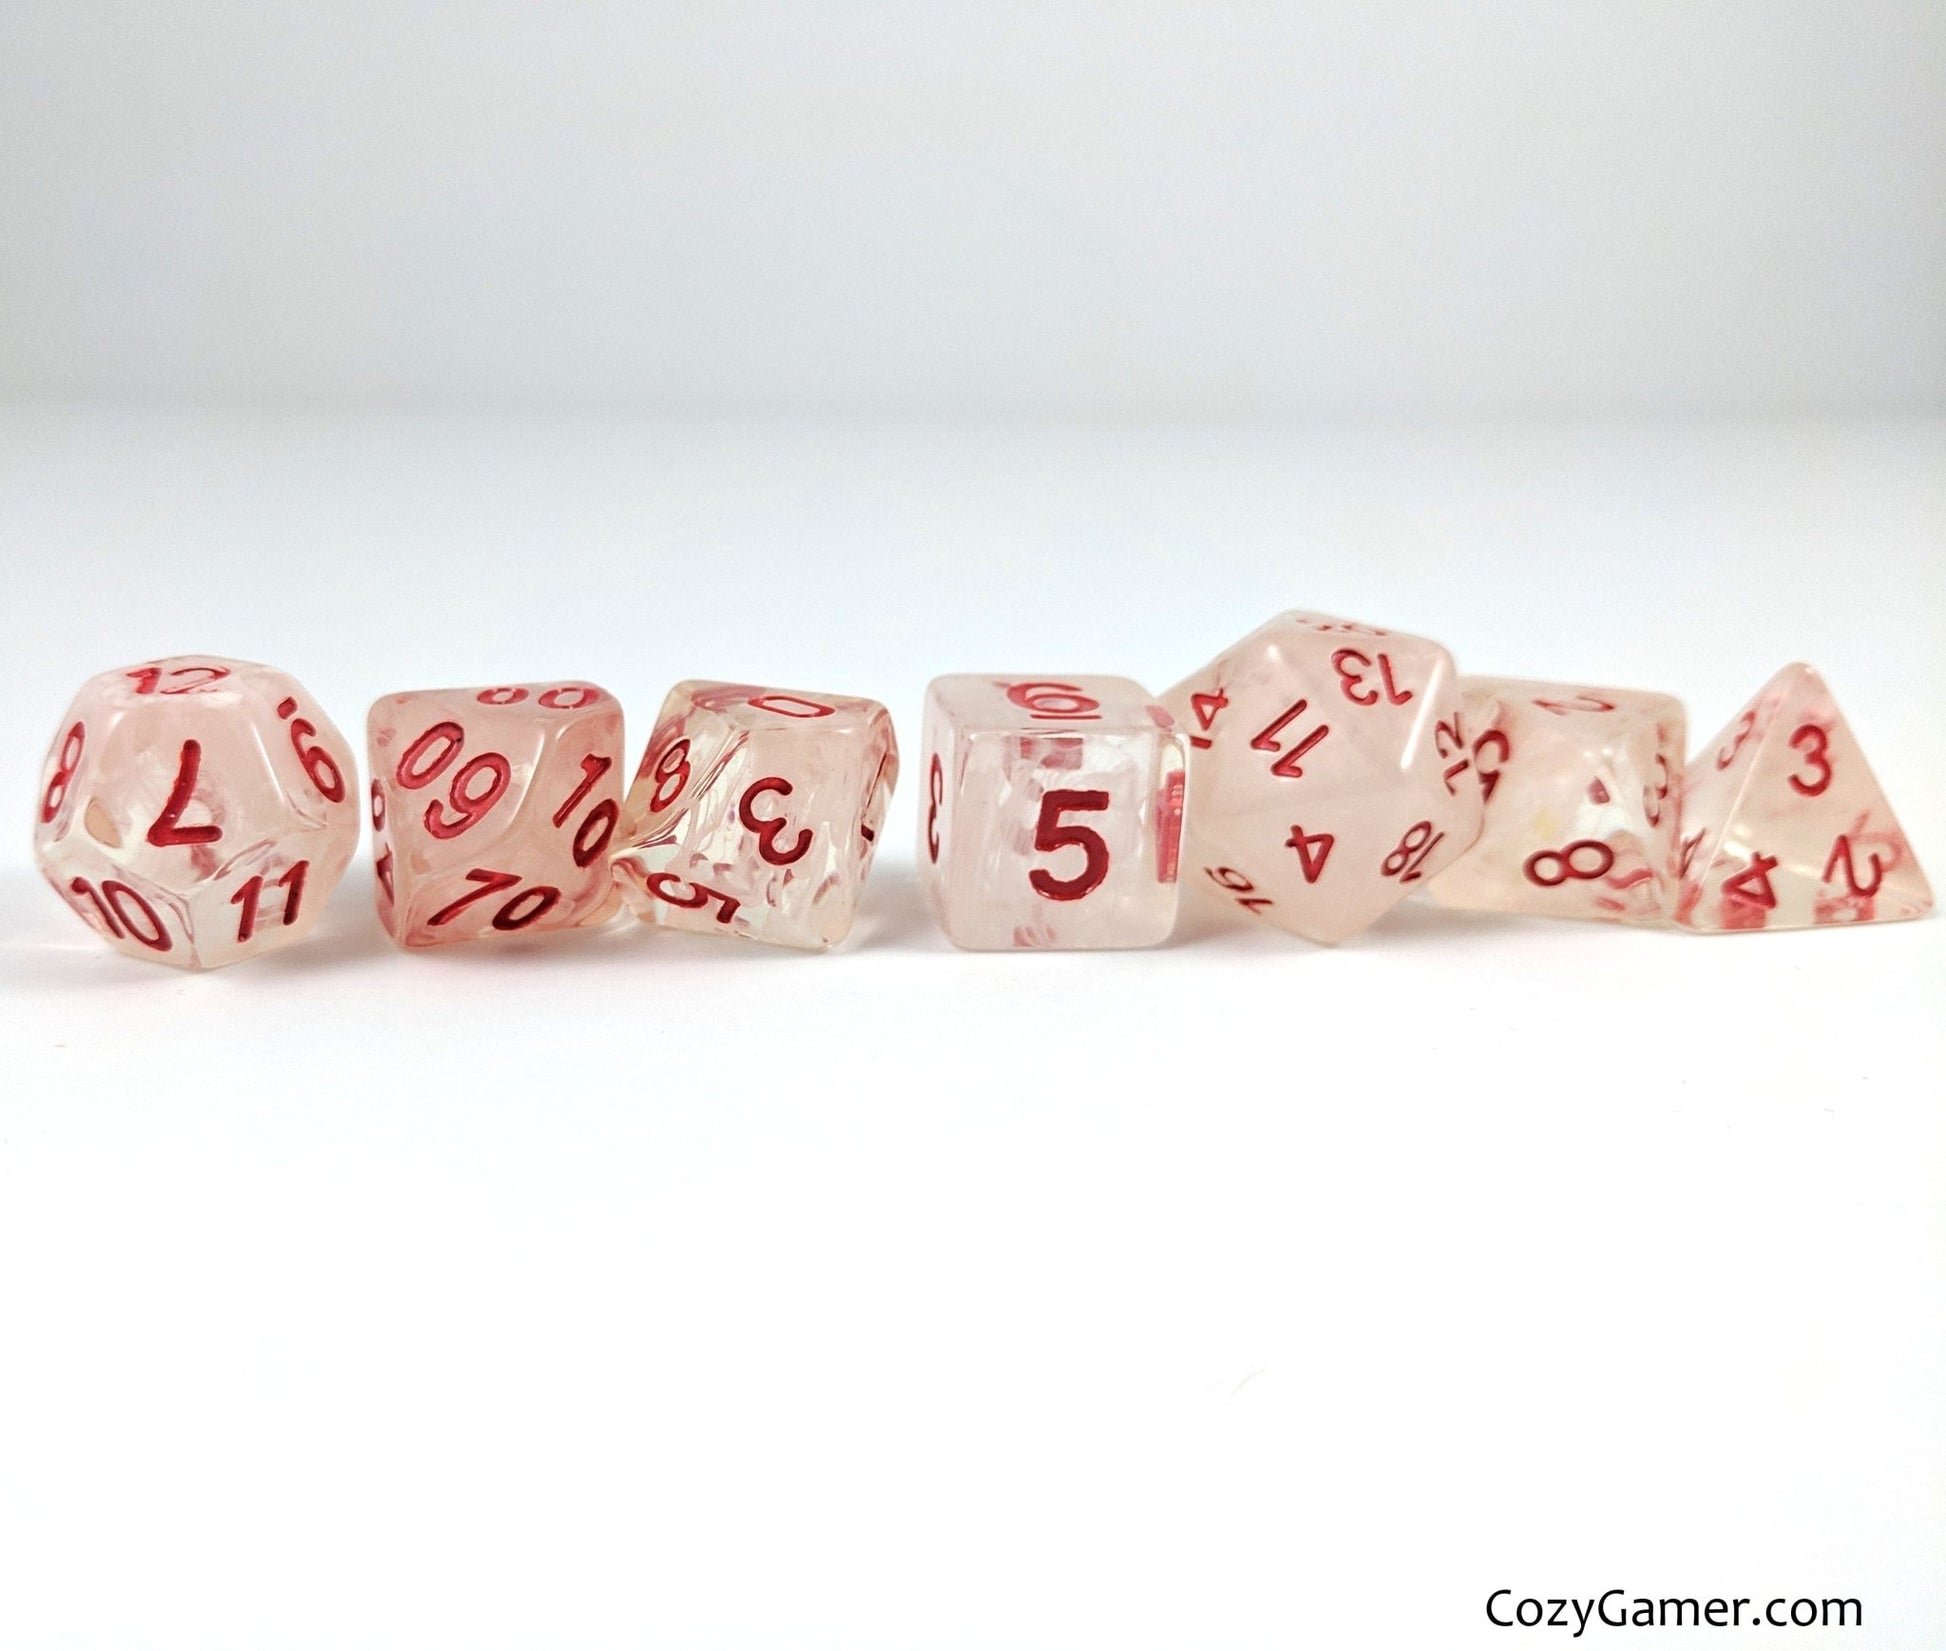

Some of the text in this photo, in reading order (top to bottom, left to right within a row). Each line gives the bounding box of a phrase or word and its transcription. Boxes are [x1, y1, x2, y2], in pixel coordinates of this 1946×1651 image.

[476, 687, 600, 710] 00
[1331, 648, 1413, 706] 13
[41, 721, 86, 824] 8
[650, 738, 691, 813] 8
[1250, 699, 1329, 778] 11
[1788, 724, 1832, 798] 3
[147, 739, 223, 847] 7
[552, 753, 619, 868] 10
[738, 776, 813, 866] 3
[1028, 788, 1110, 901] 5
[1285, 824, 1335, 884] 4
[1380, 820, 1445, 882] 18
[1524, 840, 1614, 887] 8
[1721, 851, 1778, 909] 4
[1822, 835, 1883, 898] 2
[71, 876, 173, 952] 10
[231, 860, 309, 942] 11
[427, 868, 562, 930] 70
[646, 872, 741, 924] 5
